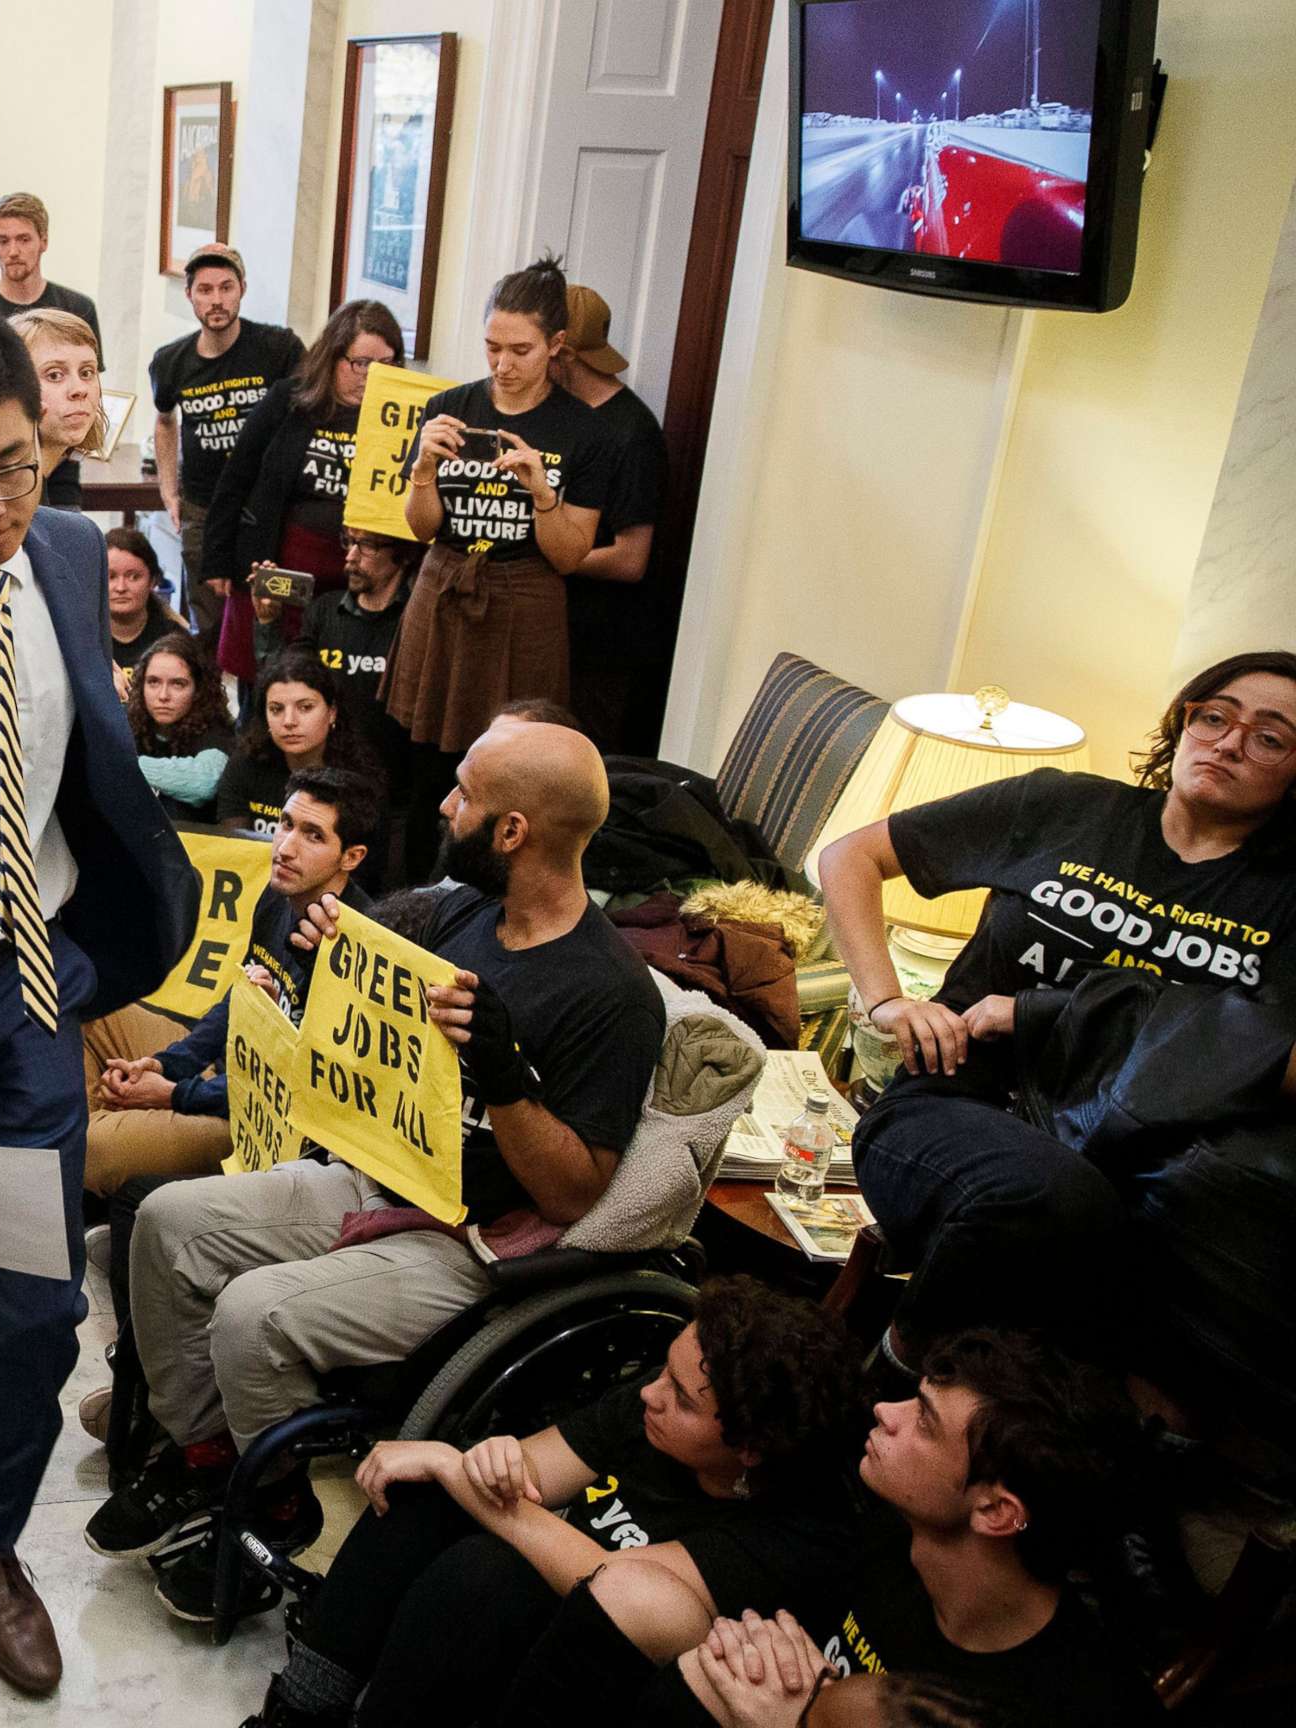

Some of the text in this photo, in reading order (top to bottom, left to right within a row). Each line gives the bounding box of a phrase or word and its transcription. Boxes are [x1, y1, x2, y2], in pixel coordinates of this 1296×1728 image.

[251, 376, 265, 386] TO
[182, 394, 225, 414] GOOD
[213, 407, 237, 420] AND
[437, 458, 499, 480] GOOD
[544, 452, 562, 465] TO
[369, 468, 408, 496] FO
[474, 481, 509, 497] AND
[454, 496, 533, 521] LIVABL
[450, 517, 530, 541] FUTURE
[319, 648, 387, 676] 12 yea
[1059, 861, 1271, 946] WE HAVE A RIGHT TO
[1030, 880, 1261, 986] GOOD JOBS
[1017, 941, 1046, 975] A
[332, 1002, 423, 1085] JOBS
[310, 1047, 378, 1119] FOR
[392, 1090, 435, 1158] ALL
[585, 1474, 619, 1504] 2
[590, 1497, 649, 1550] yea
[245, 1536, 267, 1561] ROGUE
[843, 1610, 860, 1647] WE
